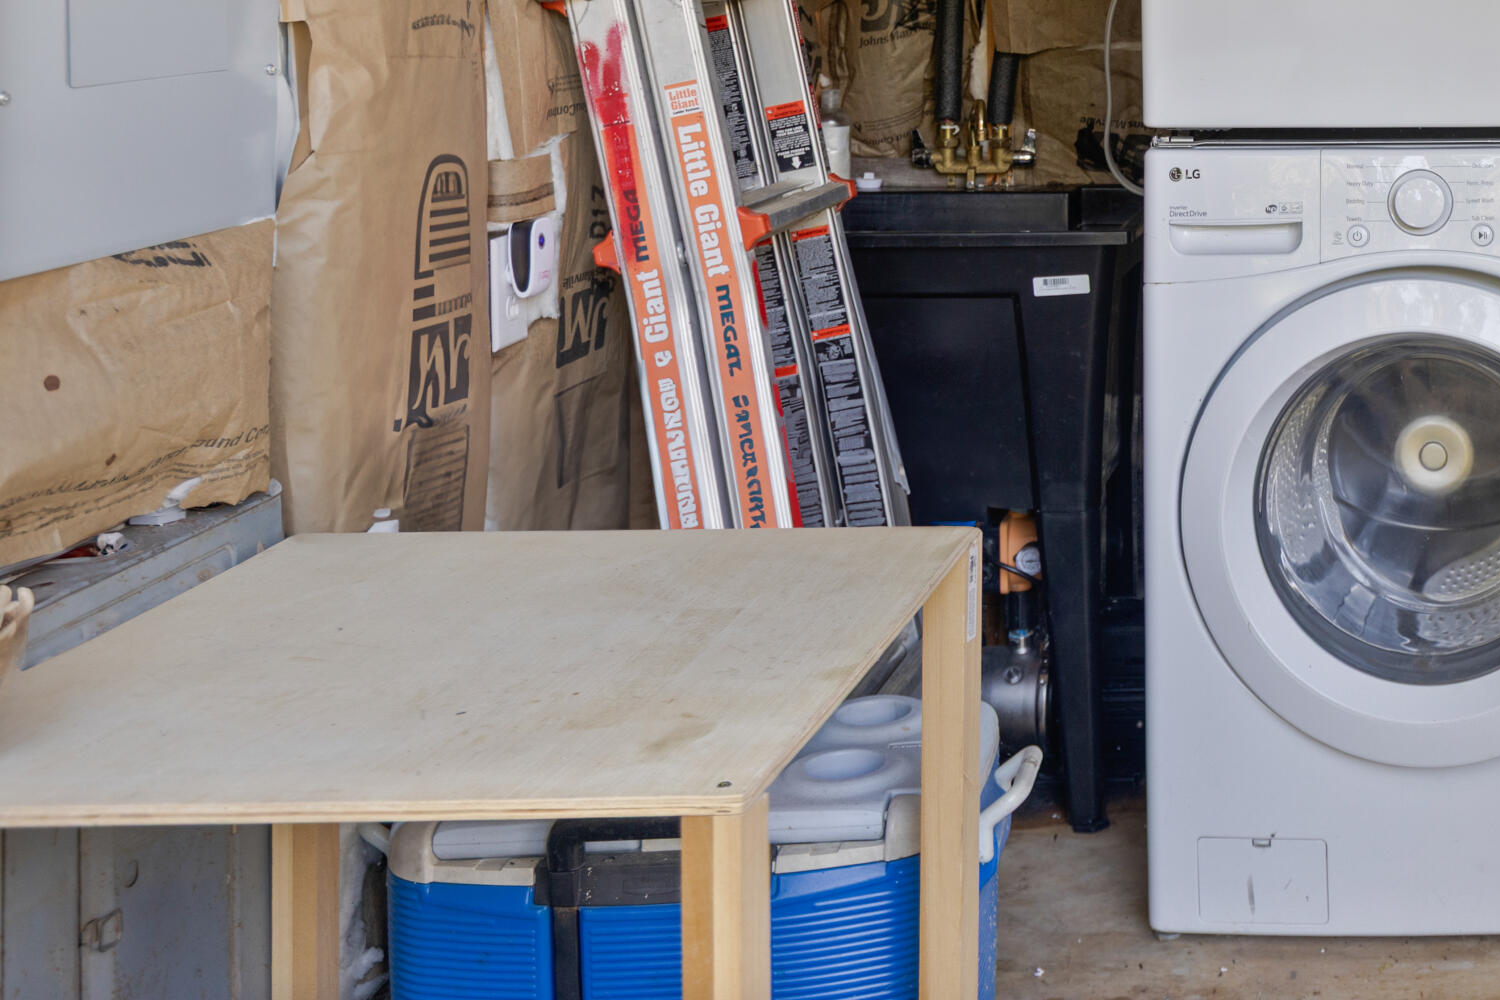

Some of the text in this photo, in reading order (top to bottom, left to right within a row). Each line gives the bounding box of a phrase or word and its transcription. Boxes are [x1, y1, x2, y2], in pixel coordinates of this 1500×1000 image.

[668, 88, 697, 101] Little
[677, 122, 712, 197] Little
[1185, 169, 1200, 179] LG
[694, 203, 730, 278] Giant
[636, 268, 669, 343] Giant
